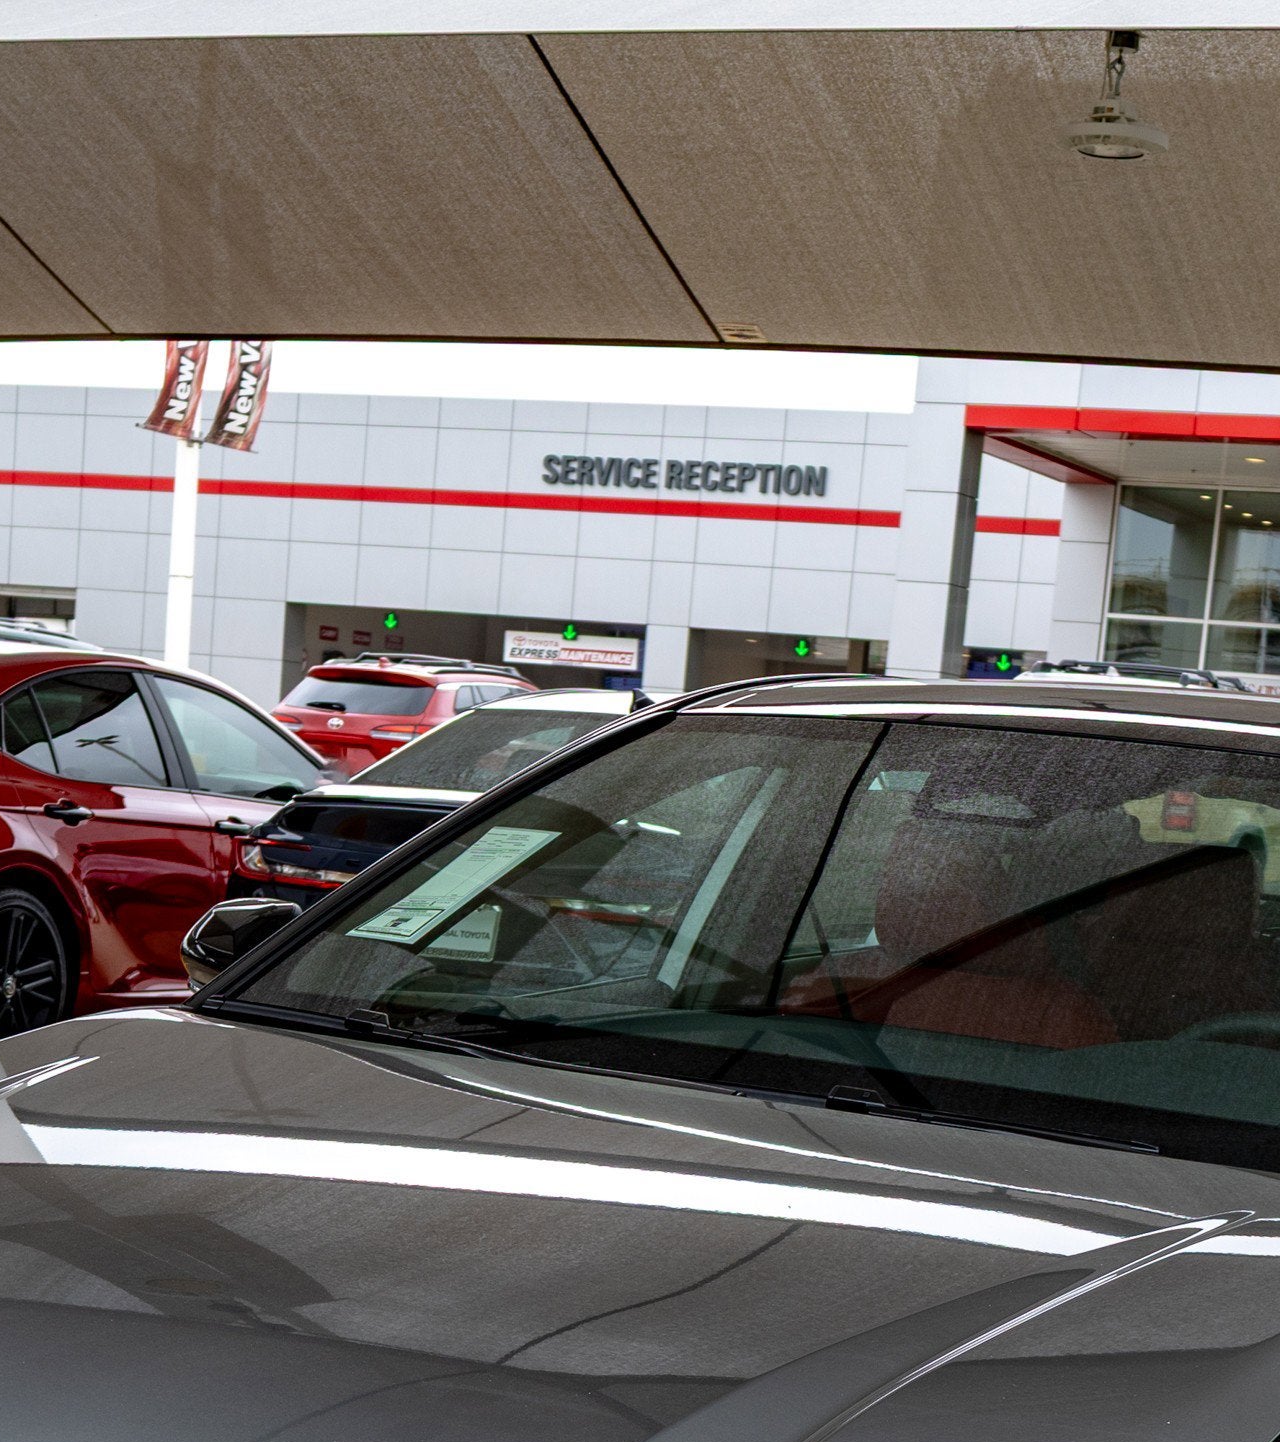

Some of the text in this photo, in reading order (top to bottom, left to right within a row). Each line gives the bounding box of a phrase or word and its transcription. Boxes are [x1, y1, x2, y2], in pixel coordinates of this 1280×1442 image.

[163, 355, 195, 421] New
[223, 370, 258, 435] New
[542, 454, 828, 496] SERVICE RECEPTION
[510, 647, 558, 659] EXPRESS
[528, 639, 559, 647] TOYOTA
[460, 930, 490, 940] TOYOTA
